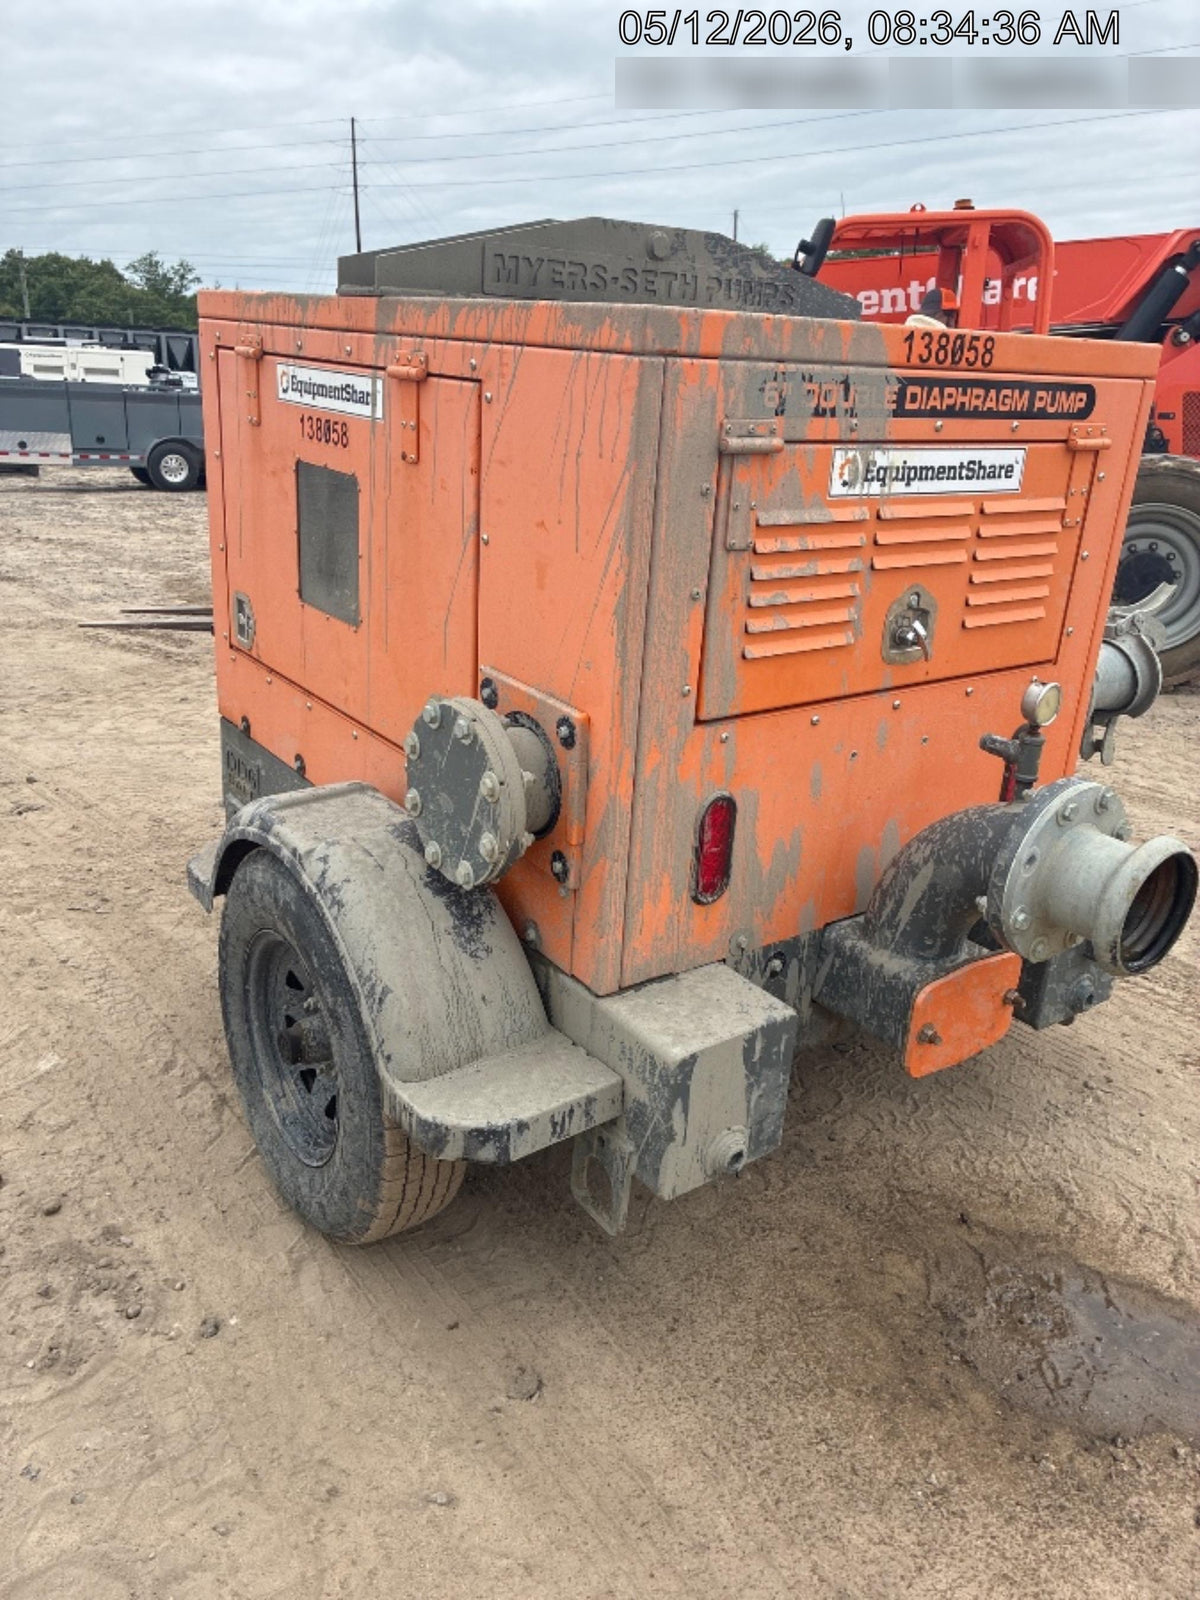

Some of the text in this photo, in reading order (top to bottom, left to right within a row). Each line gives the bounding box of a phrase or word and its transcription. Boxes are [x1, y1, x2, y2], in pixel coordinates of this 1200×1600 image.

[494, 253, 796, 307] MYERS-SETH PUMPS
[903, 330, 995, 368] 138058
[291, 374, 375, 406] EquipmentShar
[904, 385, 1030, 412] DIAPHRAGM
[1034, 389, 1087, 413] PUMP
[300, 413, 349, 448] 138058
[864, 459, 1015, 487] EquipmentShare
